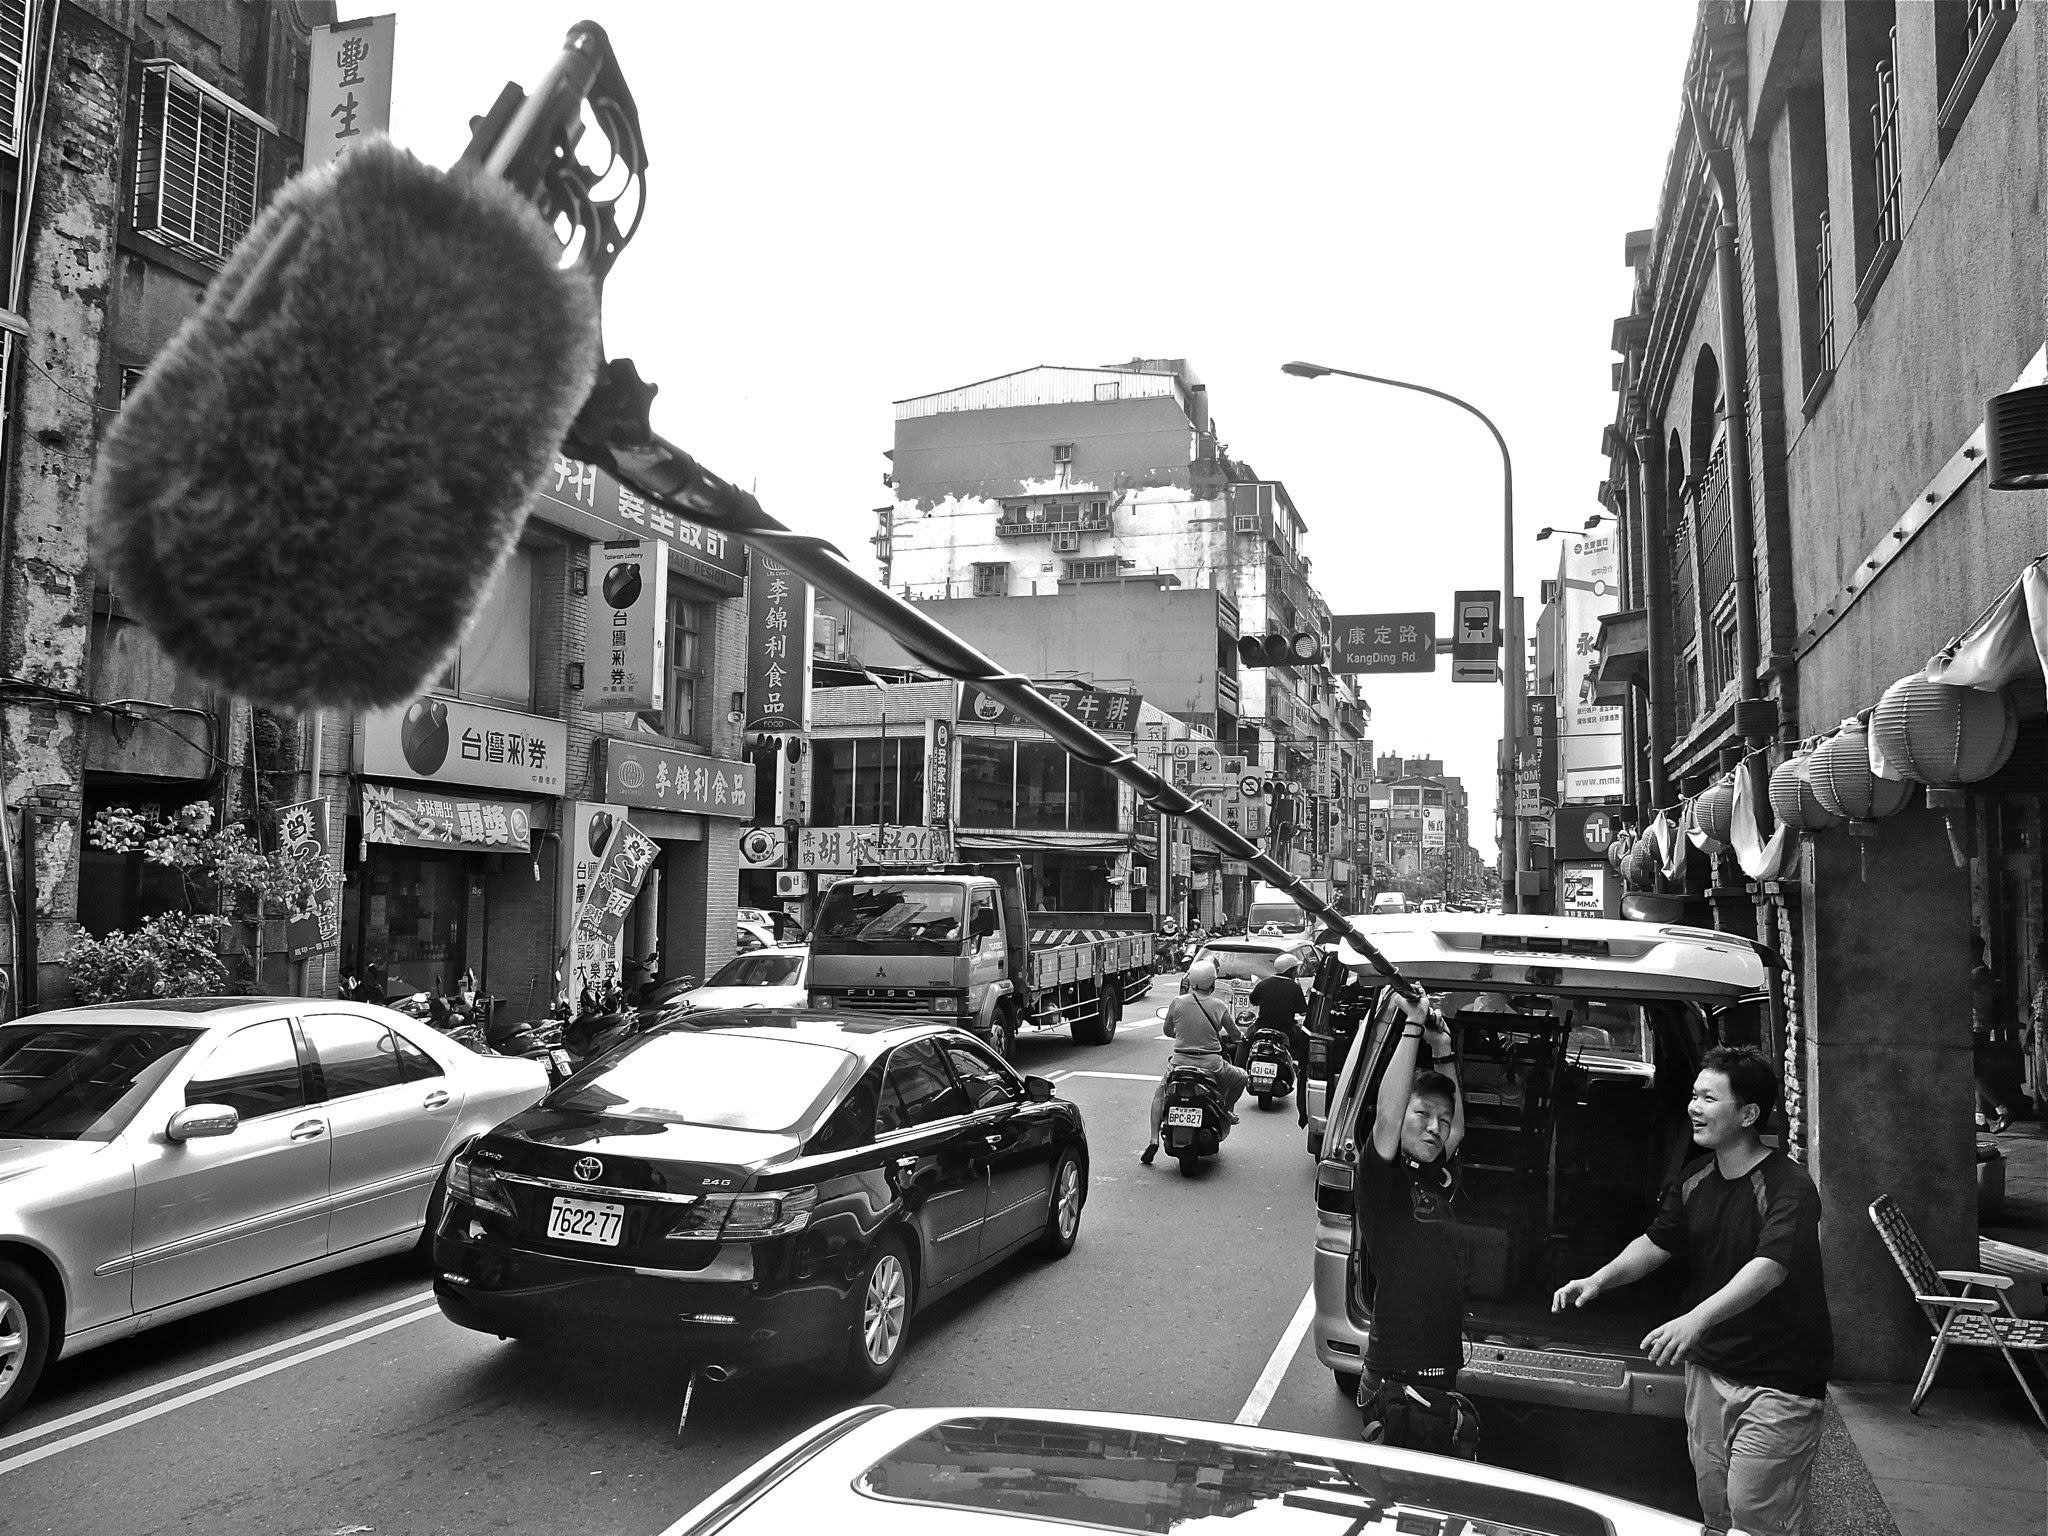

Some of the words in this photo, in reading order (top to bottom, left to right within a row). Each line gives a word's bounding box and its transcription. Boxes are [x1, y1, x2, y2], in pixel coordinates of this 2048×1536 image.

[331, 37, 369, 162] 豐生
[625, 552, 643, 561] Lottery
[694, 561, 728, 587] DESIGN
[611, 610, 628, 686] 台灣彩券
[763, 578, 790, 715] 李錦利食品
[1347, 625, 1419, 645] 康定路
[1346, 652, 1397, 666] KangDing
[763, 720, 784, 728] FOOD
[461, 727, 547, 769] 台灣彩券
[655, 760, 747, 806] 李錦利食品
[802, 830, 815, 866] 赤肉
[847, 989, 916, 997] FUSO
[1169, 1113, 1202, 1124] BPC-827
